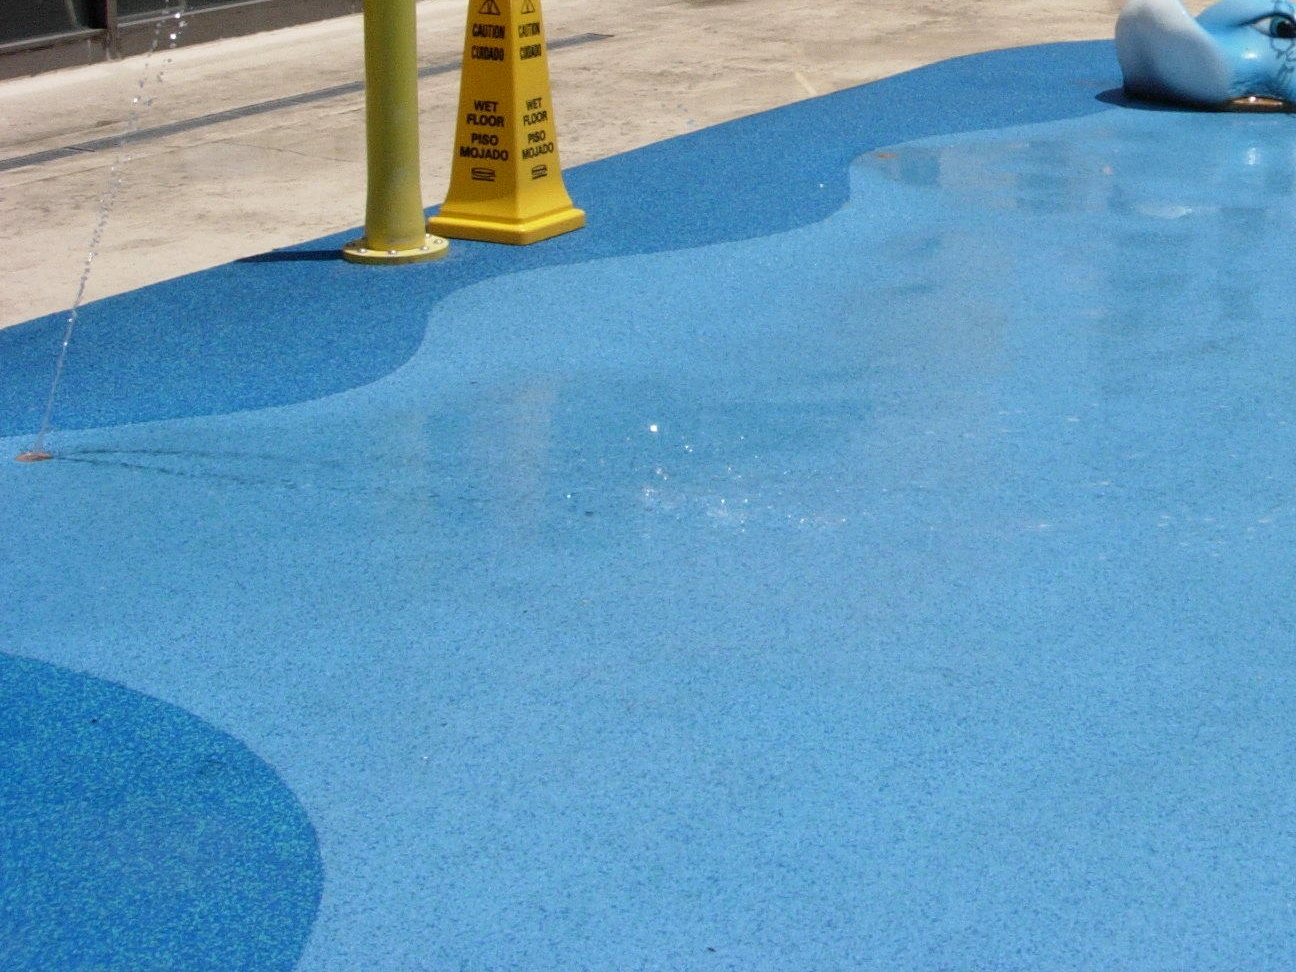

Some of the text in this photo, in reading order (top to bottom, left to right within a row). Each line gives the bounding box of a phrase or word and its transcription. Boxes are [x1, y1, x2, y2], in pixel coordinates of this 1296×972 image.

[474, 100, 498, 112] WET
[526, 97, 542, 110] WET
[467, 113, 504, 127] FLOOR
[523, 110, 547, 126] FLOOR
[471, 133, 499, 146] PISO
[527, 130, 546, 144] PISO
[460, 146, 508, 161] MOJADO
[522, 141, 554, 159] MOJADO
